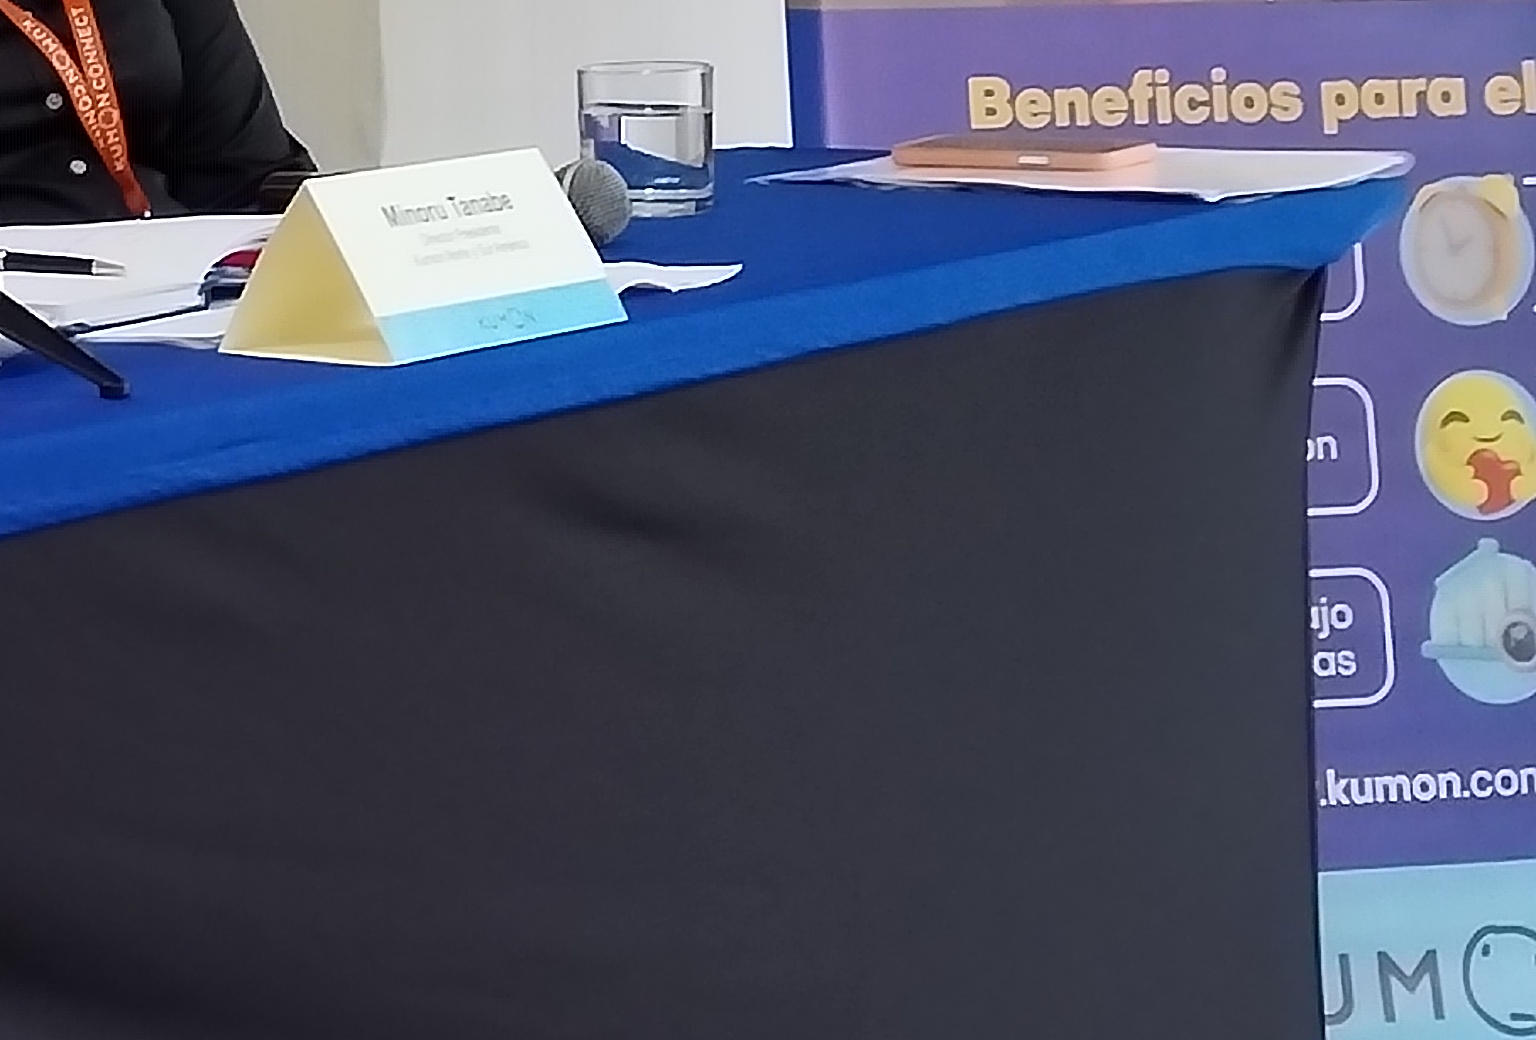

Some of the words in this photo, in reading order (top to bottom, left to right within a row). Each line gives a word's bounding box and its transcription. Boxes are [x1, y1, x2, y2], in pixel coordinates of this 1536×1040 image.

[23, 19, 79, 84] KUMON
[966, 66, 1304, 130] Beneficios
[1320, 76, 1467, 135] para
[1484, 59, 1536, 116] el
[446, 191, 514, 218] Tanabe
